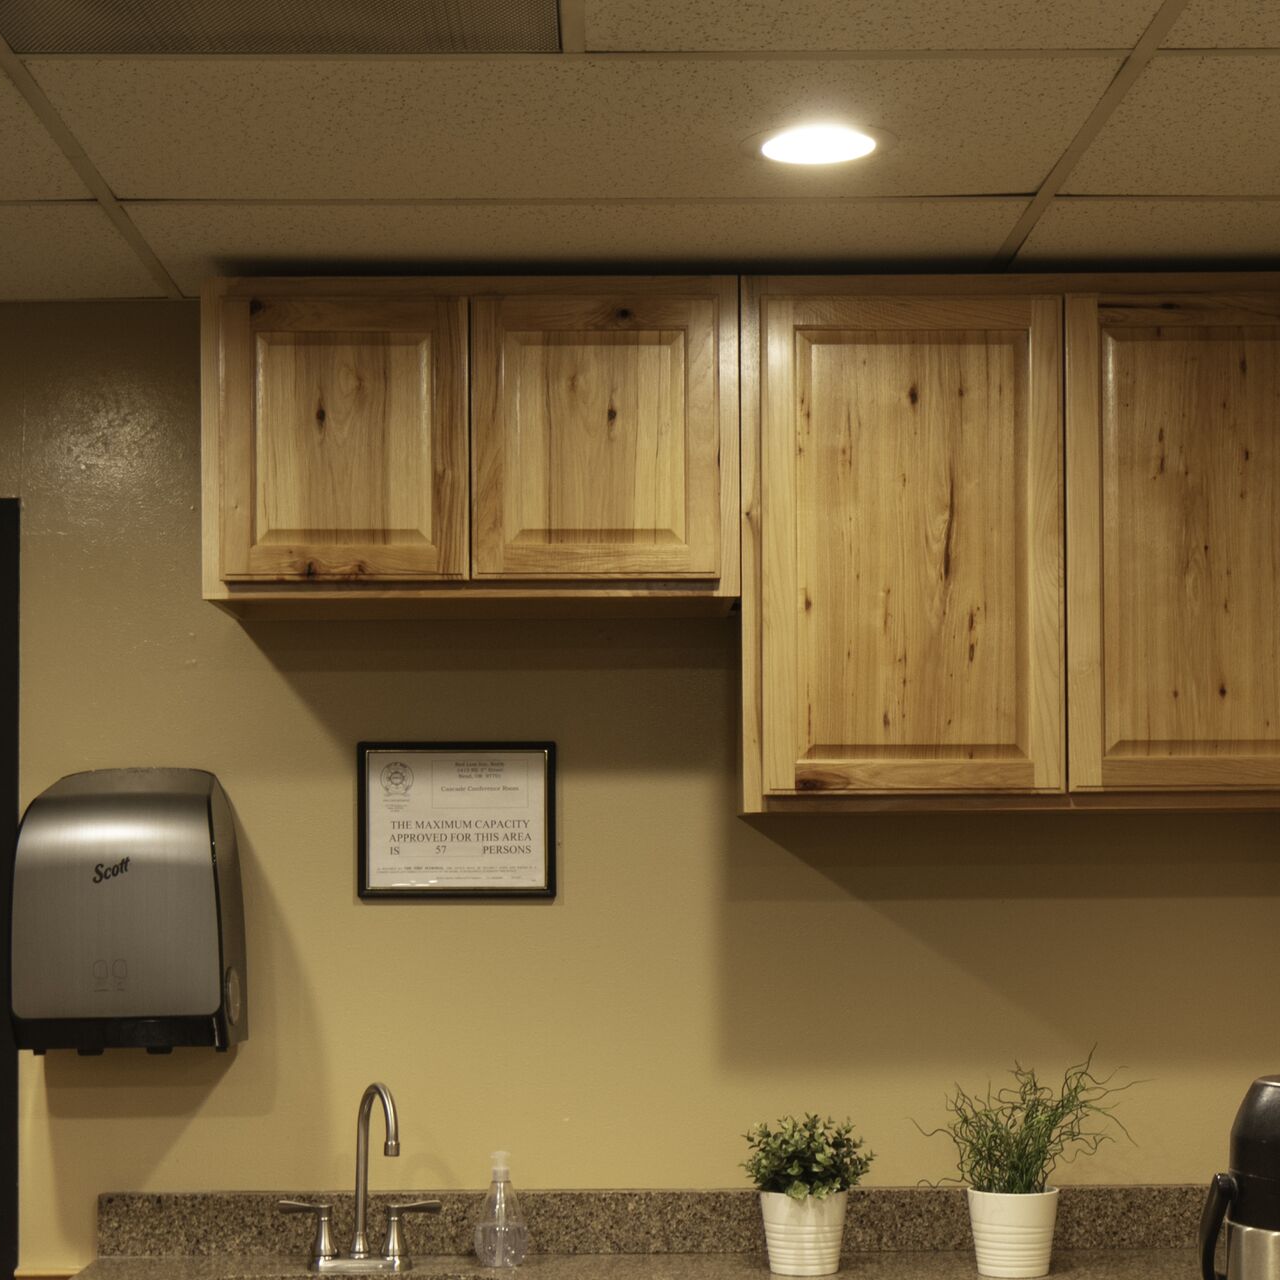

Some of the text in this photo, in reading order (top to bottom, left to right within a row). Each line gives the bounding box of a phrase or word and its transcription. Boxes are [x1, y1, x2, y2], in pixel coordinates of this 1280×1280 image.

[391, 819, 530, 830] THE MAXIMUM CAPACITY
[389, 832, 532, 843] APPROVED FOR THIS AREA
[390, 845, 532, 856] IS 57 PERSONS
[92, 856, 130, 884] Scott
